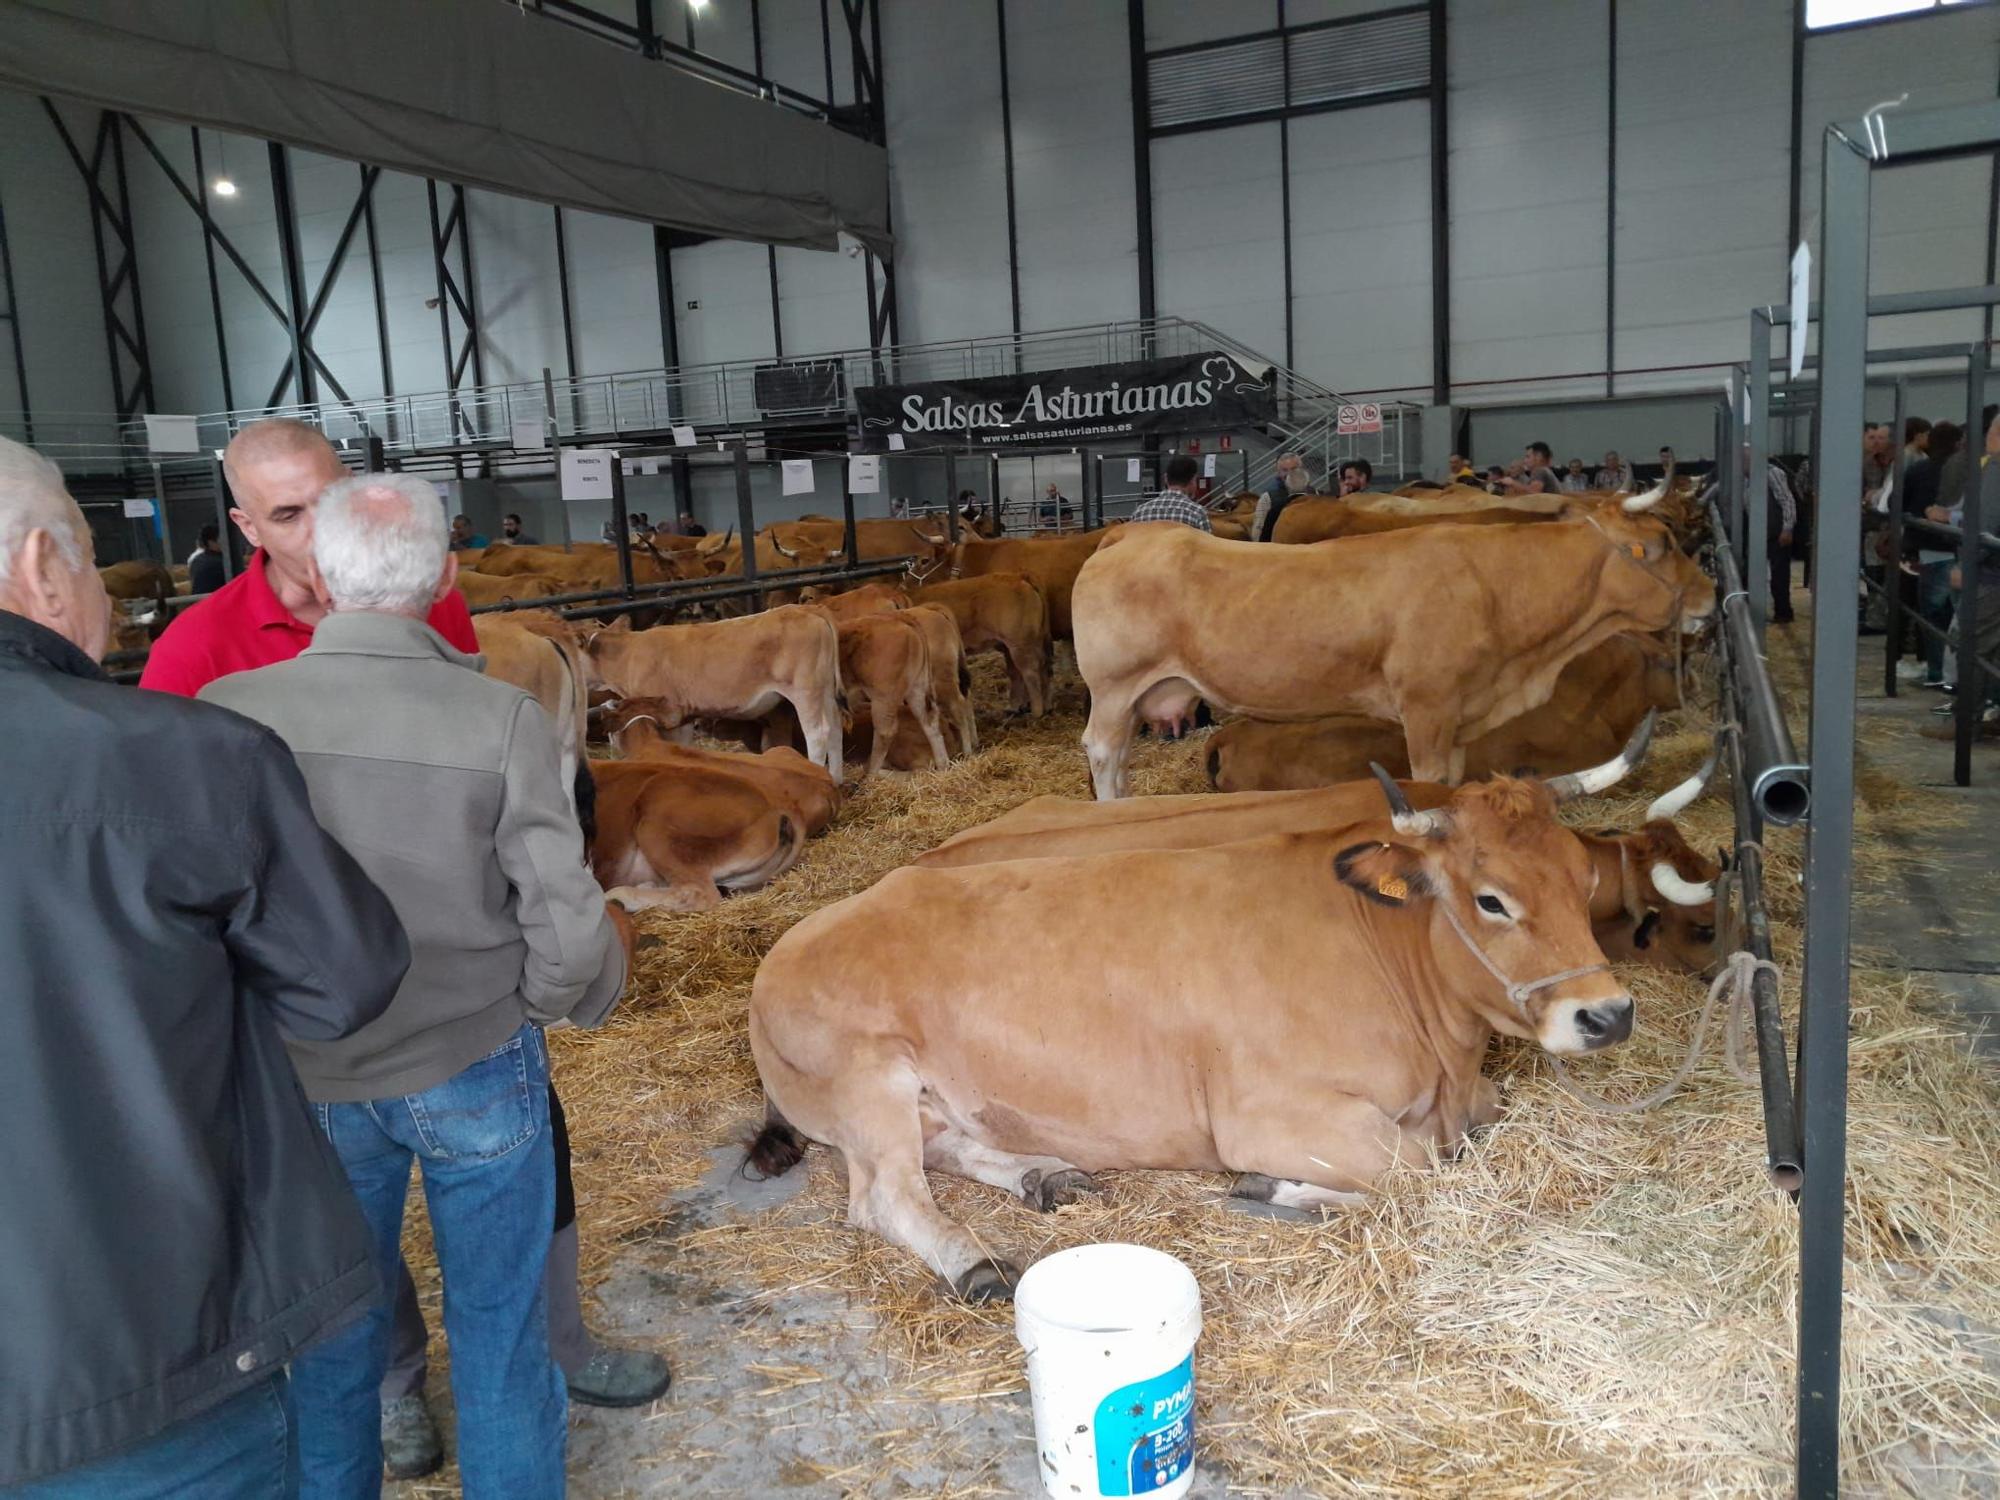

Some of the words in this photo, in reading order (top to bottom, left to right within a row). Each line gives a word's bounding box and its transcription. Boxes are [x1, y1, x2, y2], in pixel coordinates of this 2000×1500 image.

[902, 394, 1003, 432] Salsas
[1011, 378, 1213, 423] Asturianas
[982, 422, 1133, 443] www.salsasasturianas.es
